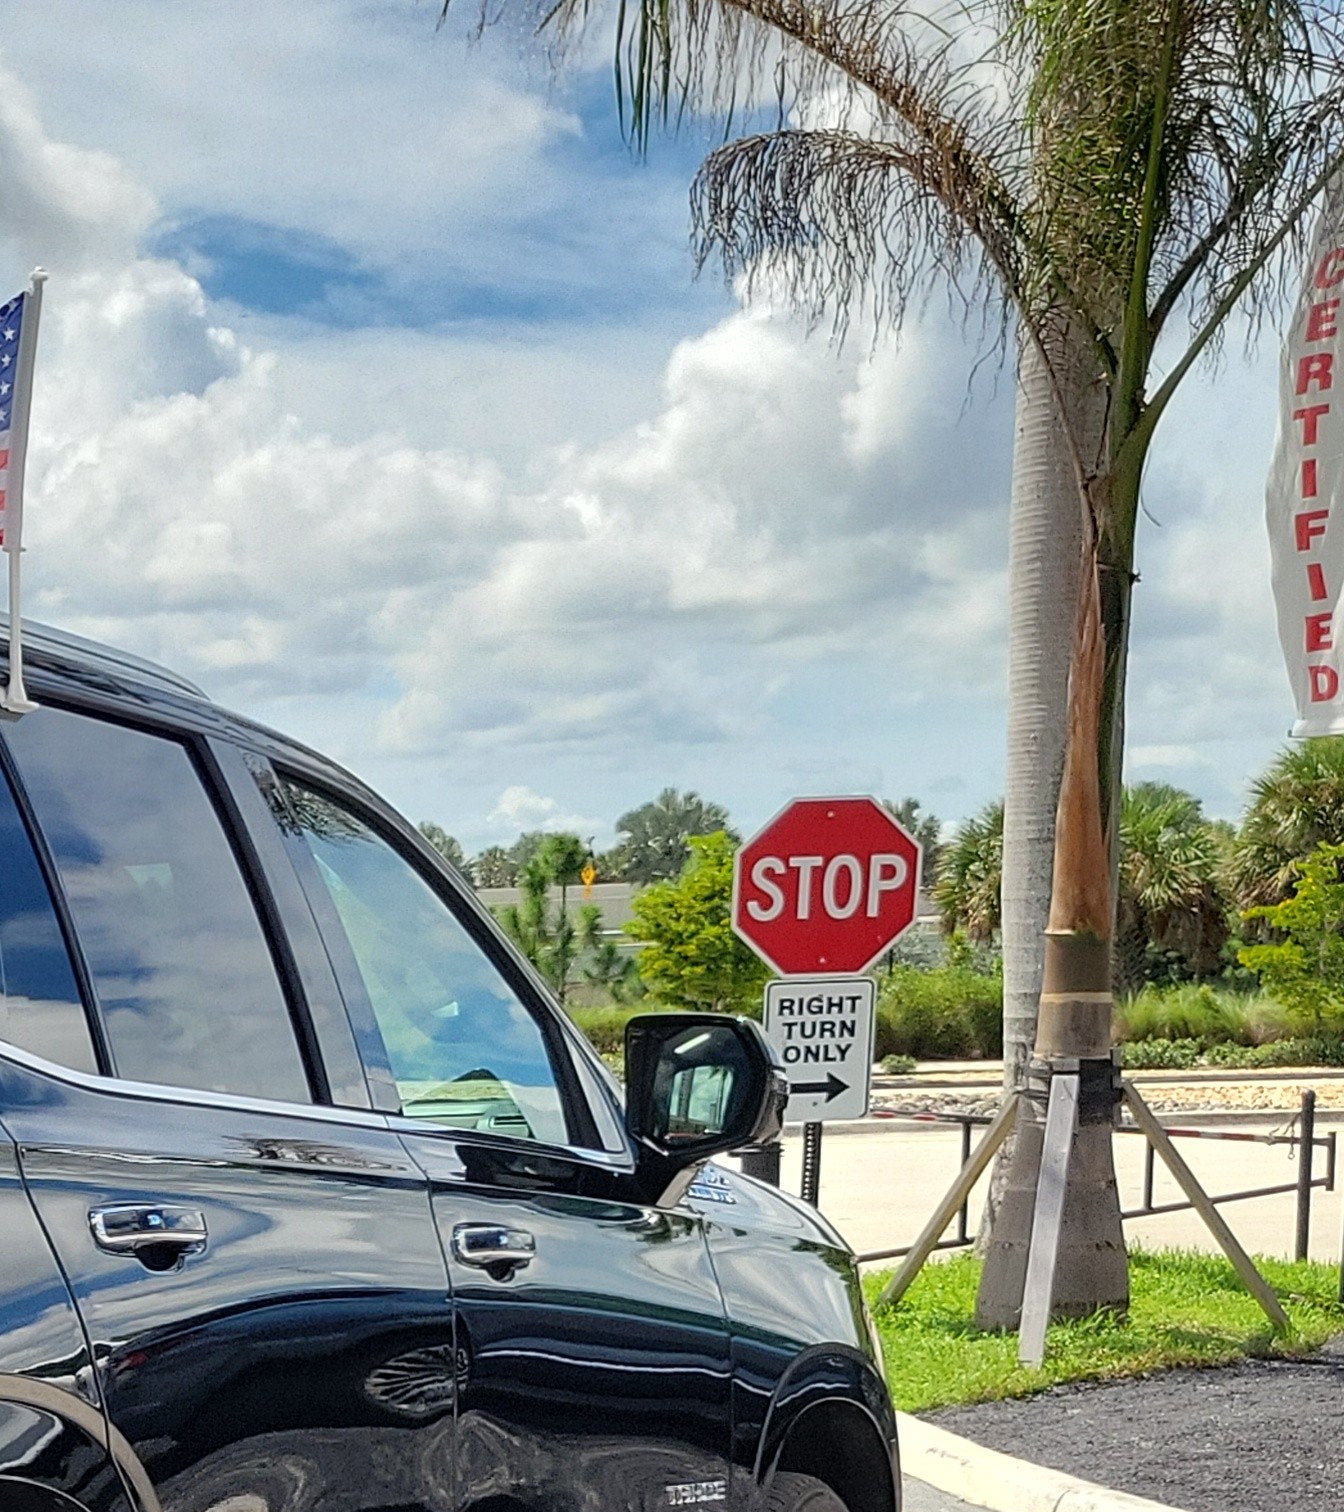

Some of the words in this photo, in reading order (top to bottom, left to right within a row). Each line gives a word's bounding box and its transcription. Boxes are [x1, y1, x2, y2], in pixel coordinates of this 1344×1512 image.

[1294, 248, 1344, 704] CERTIFIED
[746, 854, 908, 922] STOP
[778, 995, 862, 1016] RIGHT
[782, 1020, 856, 1040] TURN
[783, 1043, 852, 1063] ONLY
